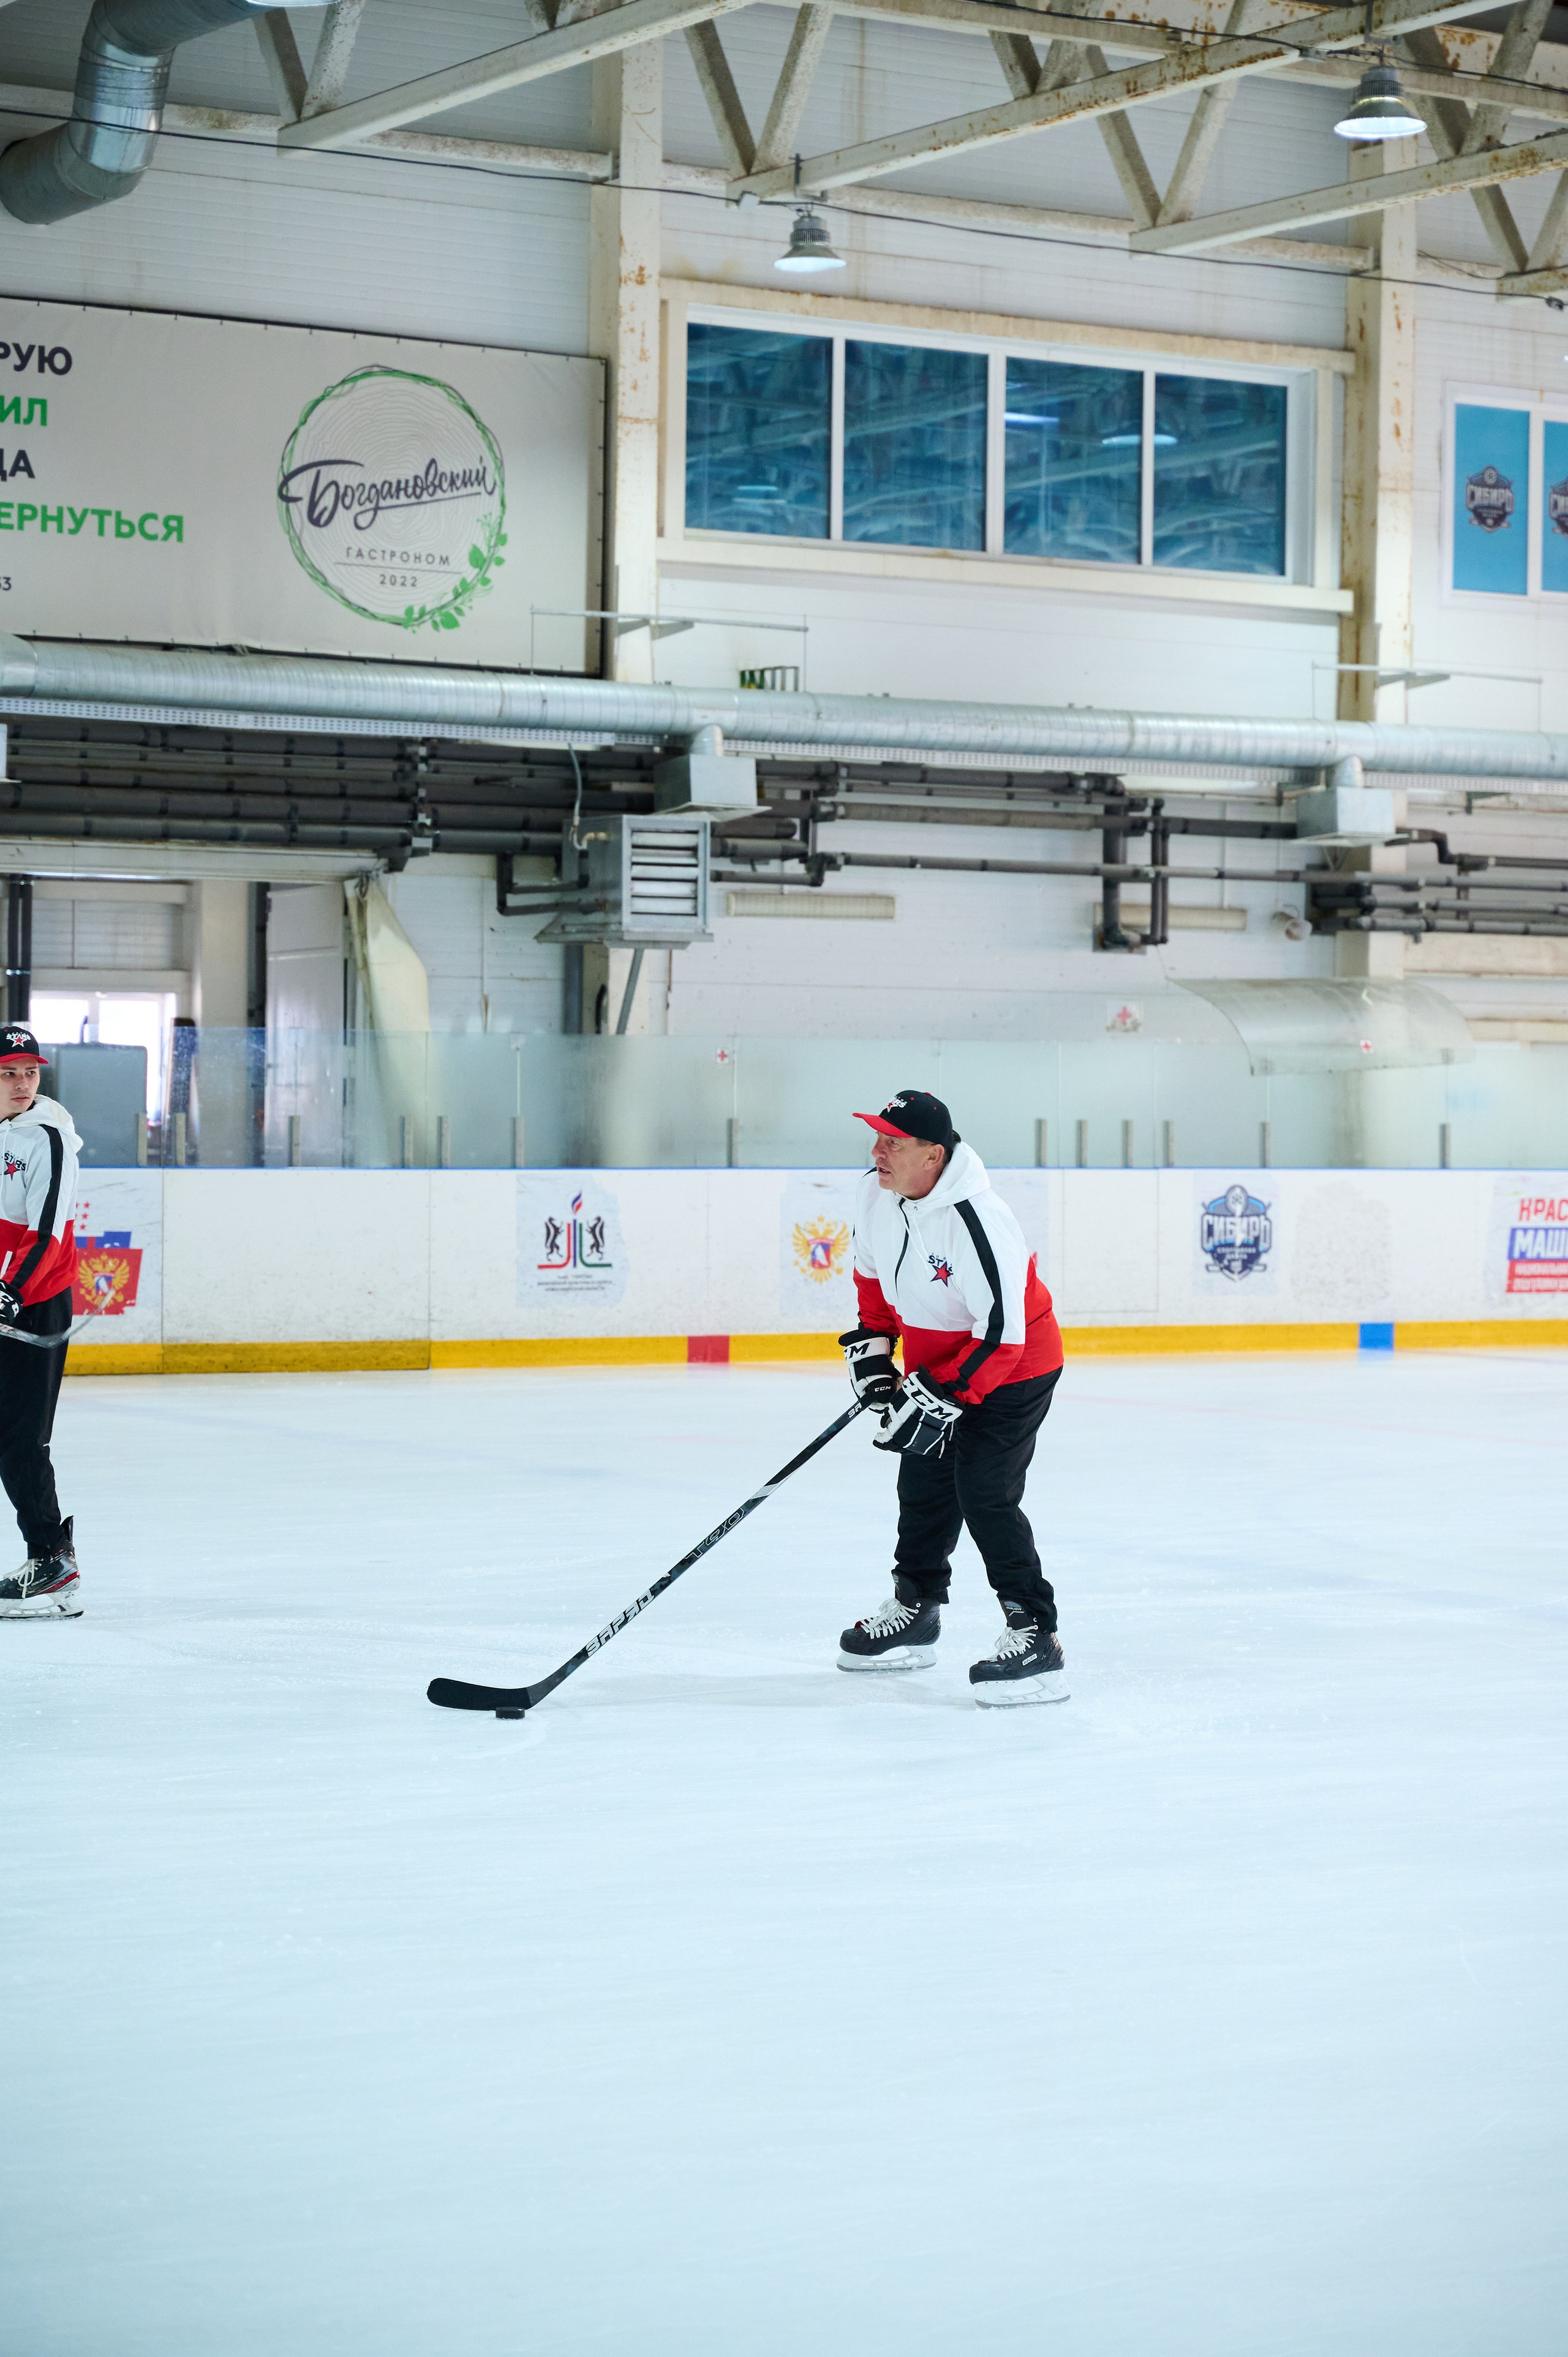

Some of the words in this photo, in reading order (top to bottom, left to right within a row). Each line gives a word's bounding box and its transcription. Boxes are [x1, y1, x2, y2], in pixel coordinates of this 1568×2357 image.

[278, 456, 496, 530] Богдановский
[1466, 483, 1513, 513] СИБИРЬ
[346, 548, 450, 566] ГАСТРОНОМ
[379, 575, 418, 587] 2022
[1202, 1214, 1271, 1251] СИБИРЬ
